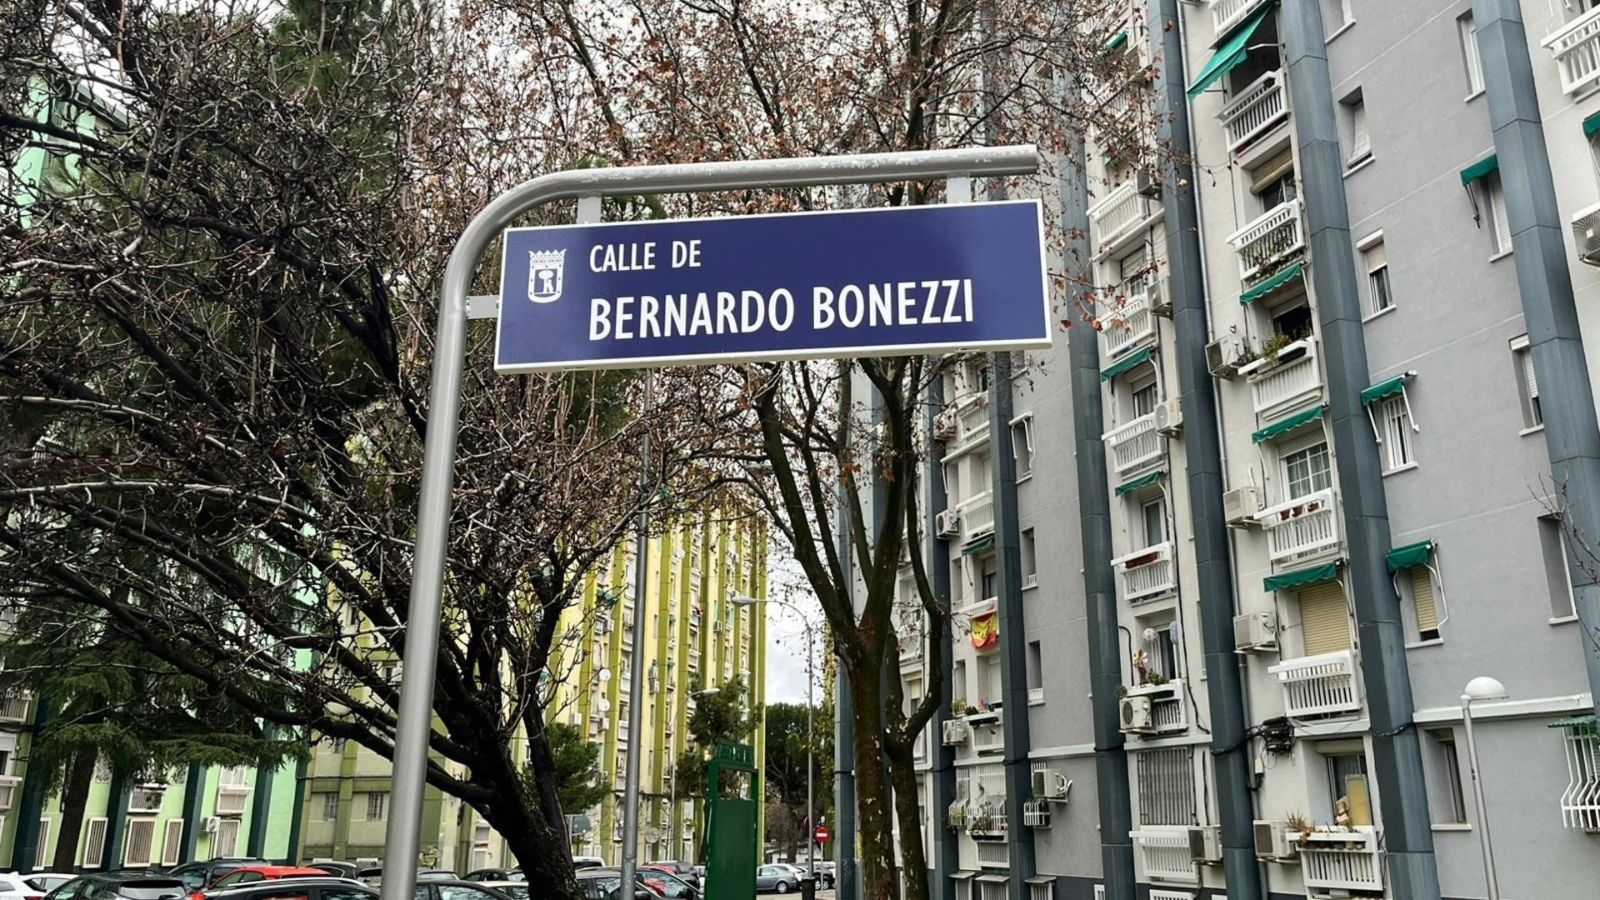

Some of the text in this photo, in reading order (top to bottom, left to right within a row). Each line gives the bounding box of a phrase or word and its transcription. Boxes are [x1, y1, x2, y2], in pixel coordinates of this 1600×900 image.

[589, 239, 702, 274] CALLE DE
[588, 278, 974, 341] BERNARDO BONEZZI
